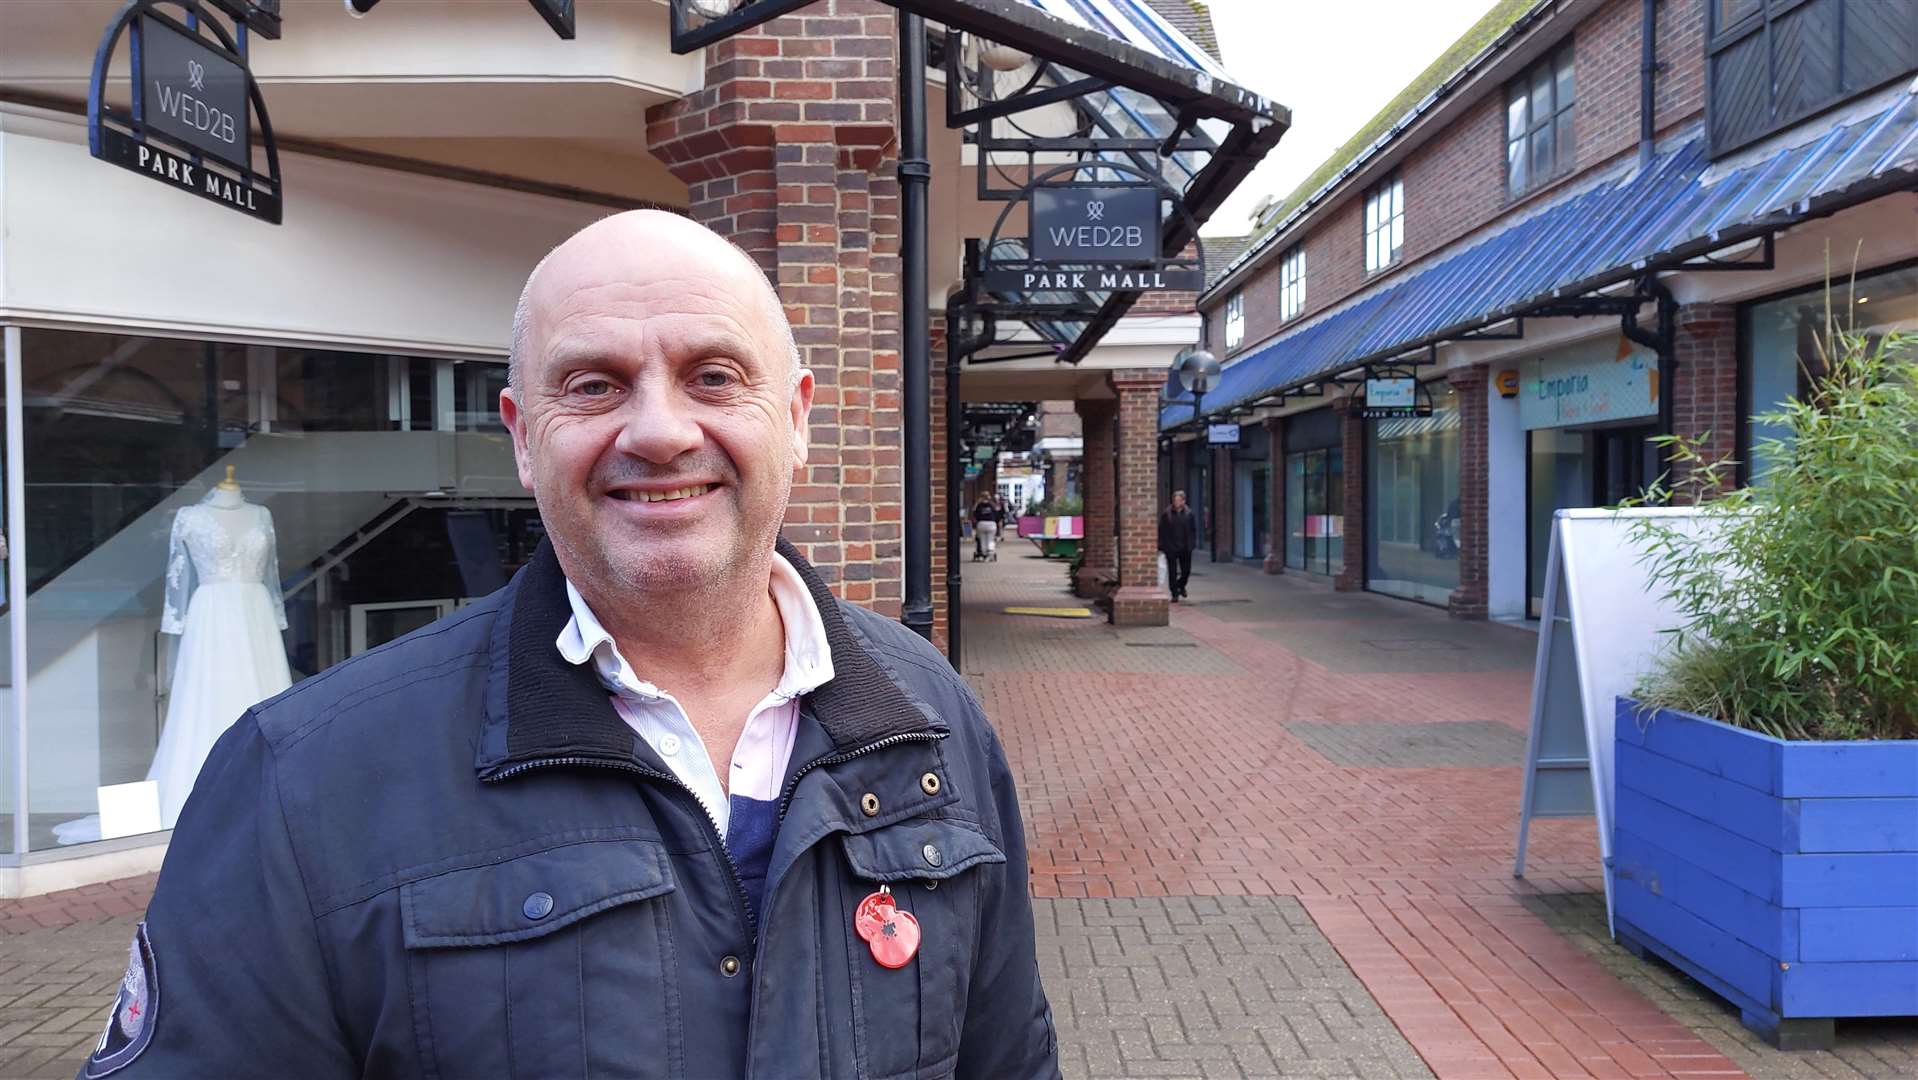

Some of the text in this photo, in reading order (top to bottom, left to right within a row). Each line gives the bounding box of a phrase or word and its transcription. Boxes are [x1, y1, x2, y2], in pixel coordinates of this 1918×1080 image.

[155, 81, 236, 144] WED2B
[138, 145, 257, 210] PARK MALL
[1049, 225, 1143, 247] WED2B
[1023, 273, 1167, 289] PARK MALL
[1538, 358, 1589, 421] Emporia
